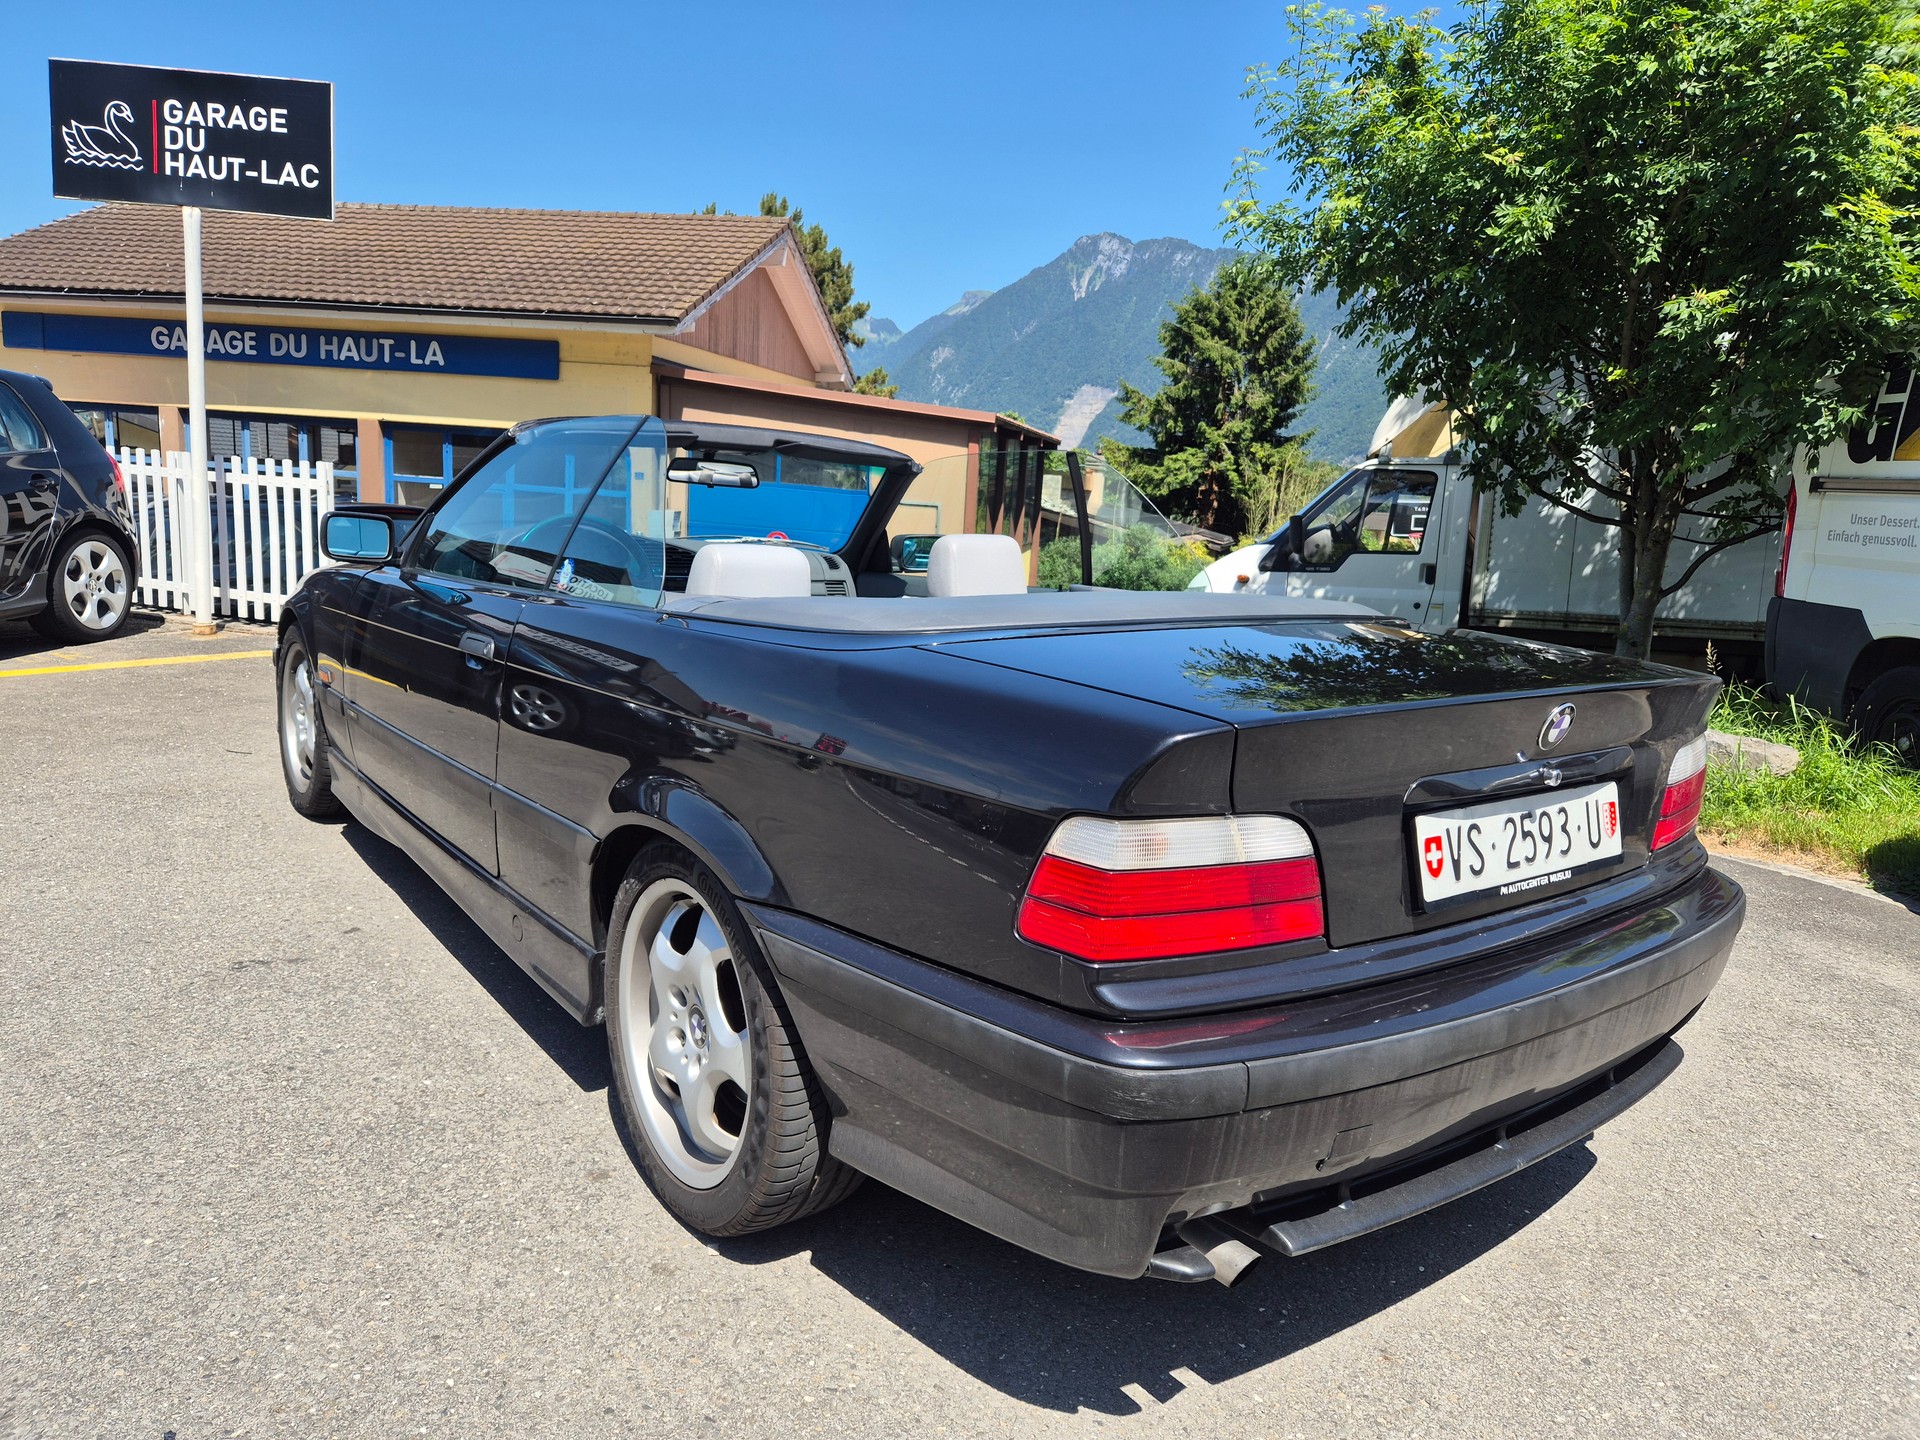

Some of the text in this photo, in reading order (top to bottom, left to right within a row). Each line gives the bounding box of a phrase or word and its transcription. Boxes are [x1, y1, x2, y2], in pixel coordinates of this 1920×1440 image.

[163, 98, 288, 134] GARAGE
[164, 125, 205, 152] DU
[165, 151, 319, 188] HAUT-LAC
[150, 325, 445, 366] GAAGE DU HAUT-LA
[1850, 512, 1920, 529] Unser Dessert.
[1827, 529, 1917, 548] Einfach genussvoll.
[1508, 875, 1549, 894] AUTOCENTER
